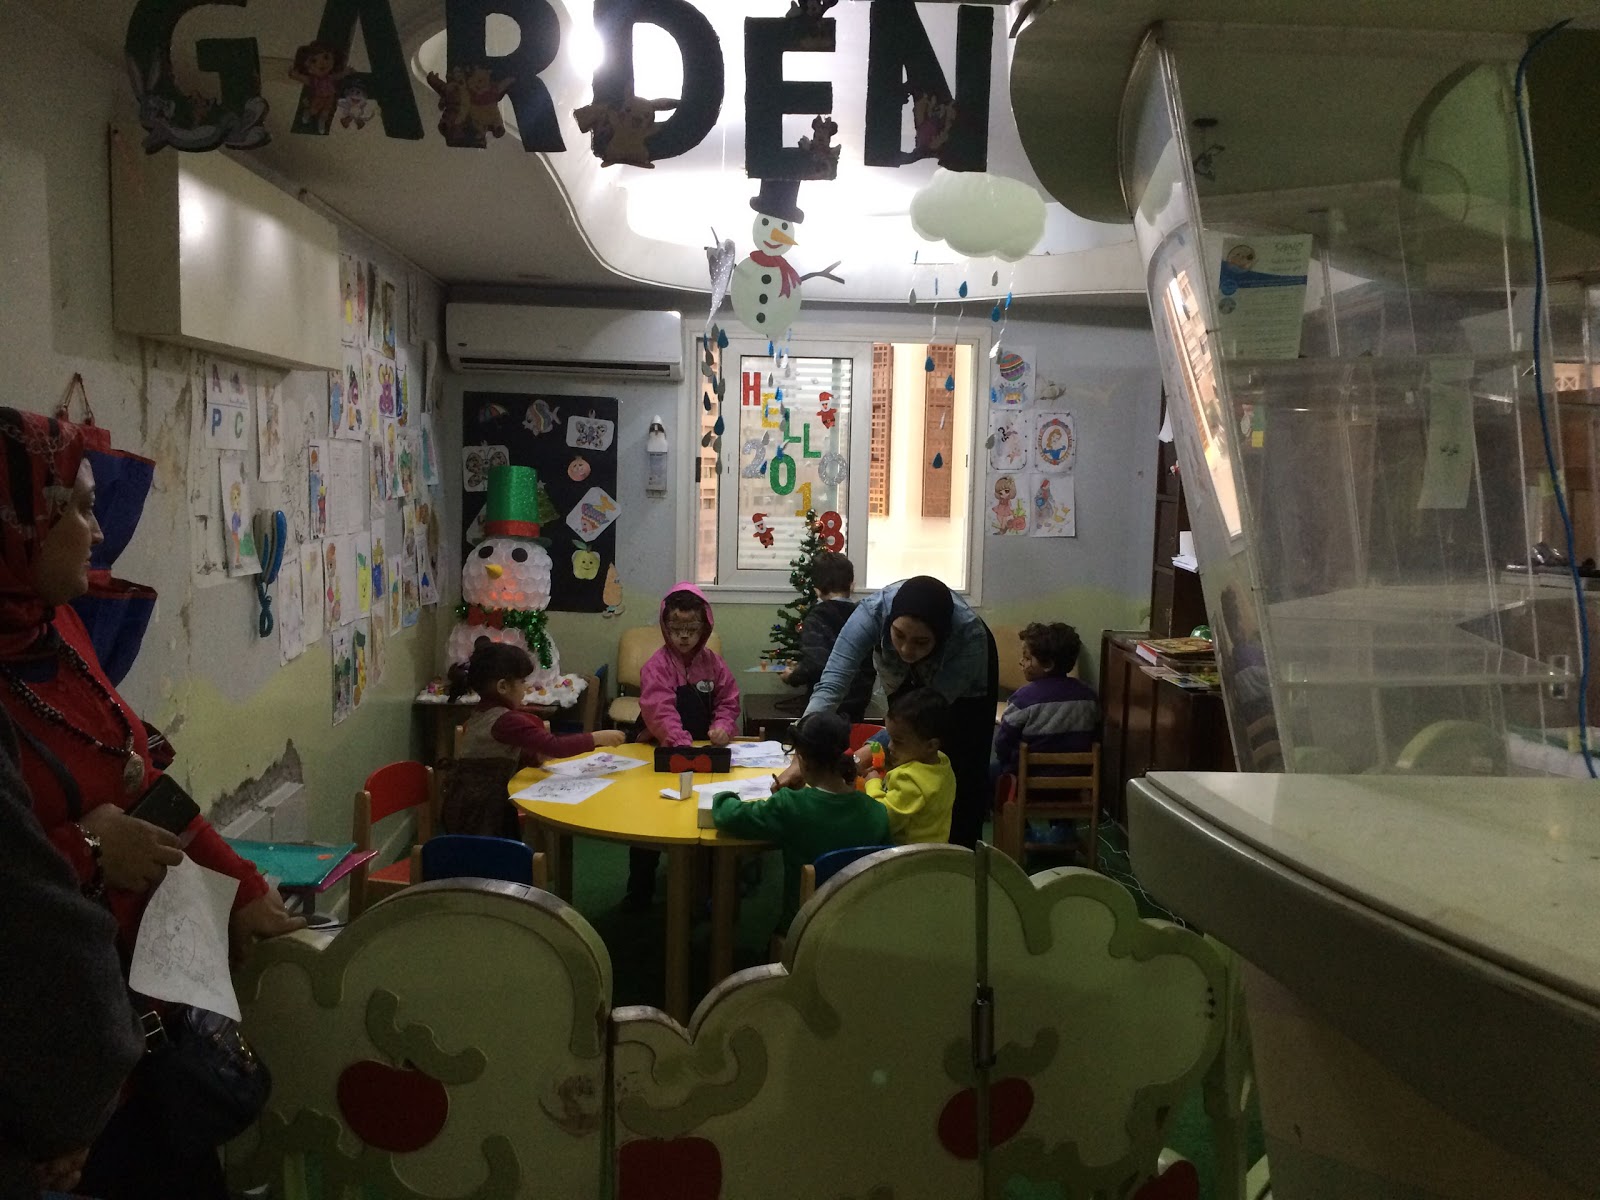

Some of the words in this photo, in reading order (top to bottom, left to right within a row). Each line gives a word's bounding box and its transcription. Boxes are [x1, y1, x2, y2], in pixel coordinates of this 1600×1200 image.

[127, 0, 993, 180] GARDEN
[212, 363, 222, 393] A
[212, 408, 222, 436] P
[234, 411, 243, 438] C
[742, 372, 847, 486] HELLO
[742, 438, 845, 555] 2018
